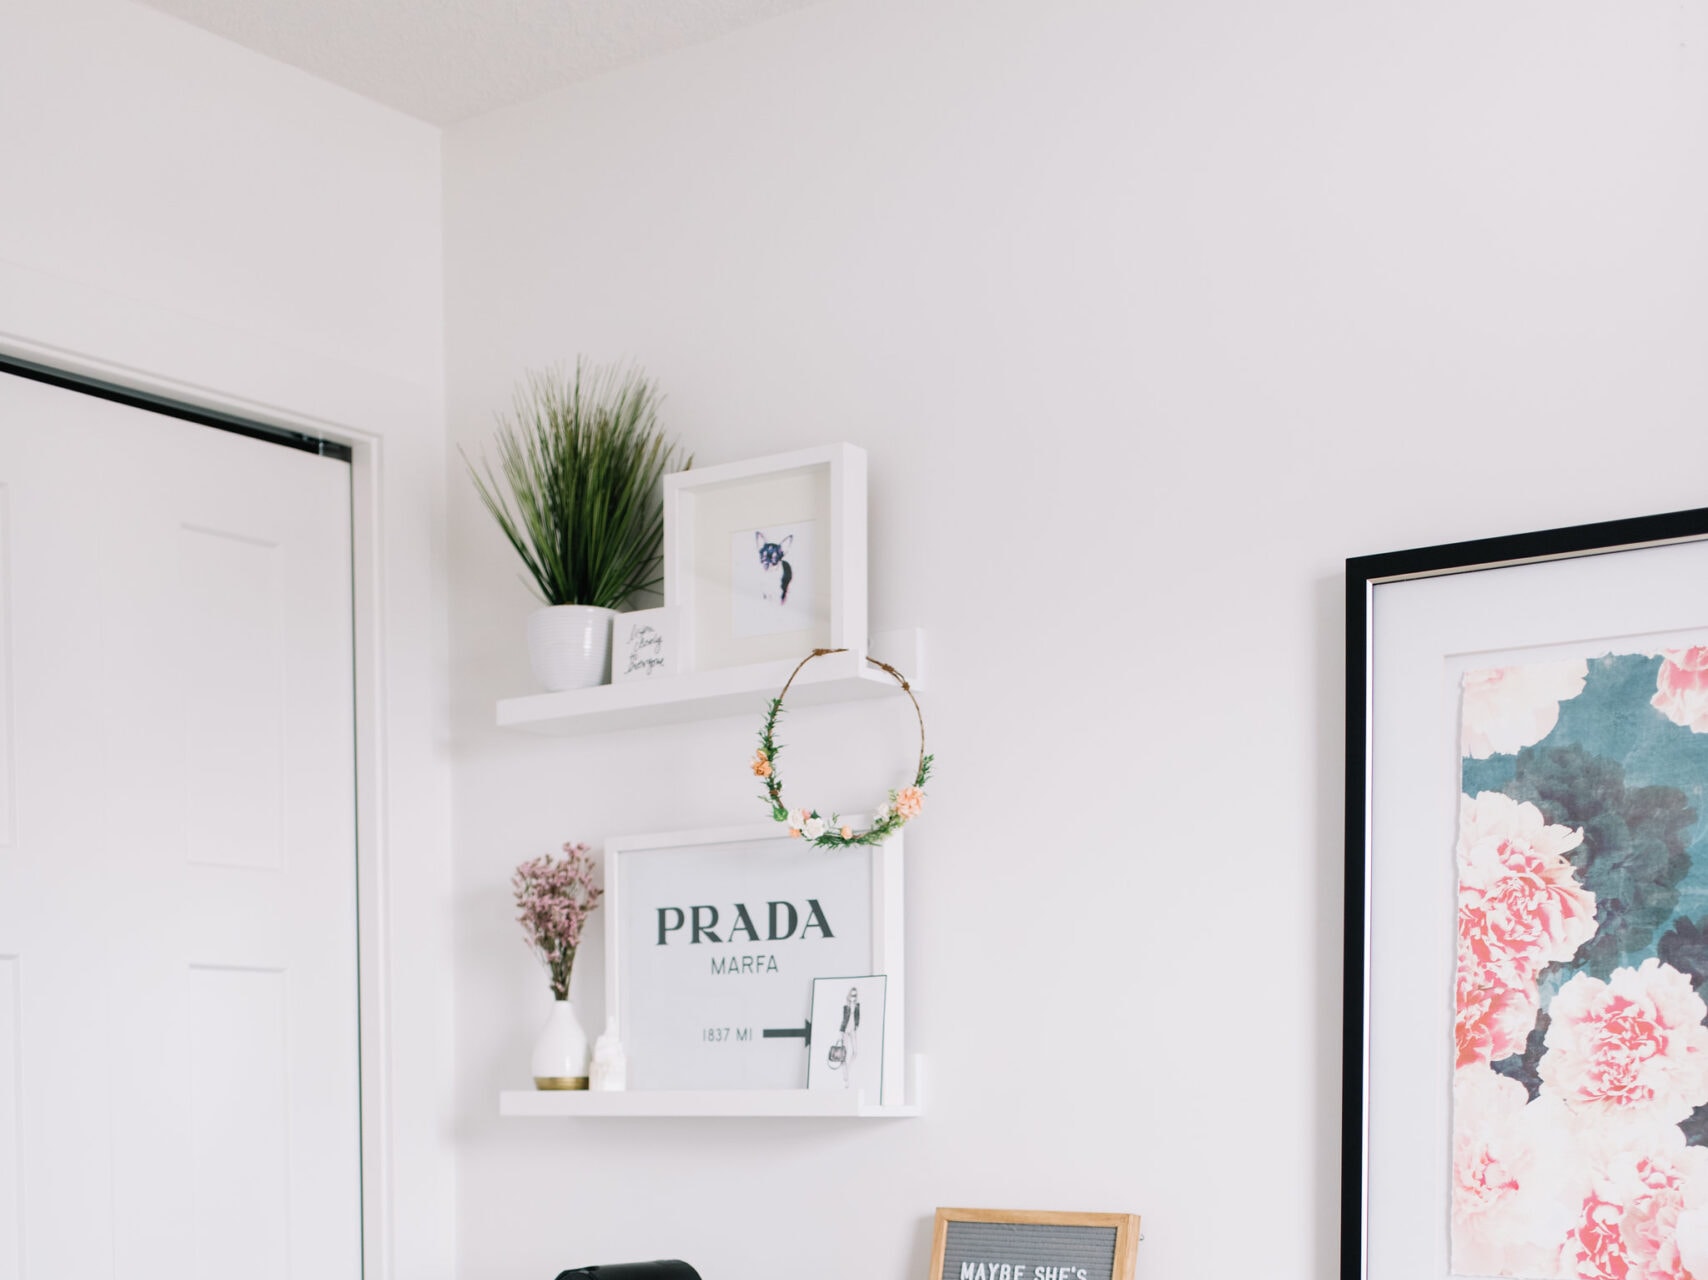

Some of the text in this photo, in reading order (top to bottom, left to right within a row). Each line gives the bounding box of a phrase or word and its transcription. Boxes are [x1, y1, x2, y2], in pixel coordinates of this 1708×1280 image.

[655, 899, 835, 945] PRADA
[711, 954, 779, 975] MARFA
[703, 1027, 753, 1042] 1837 MI
